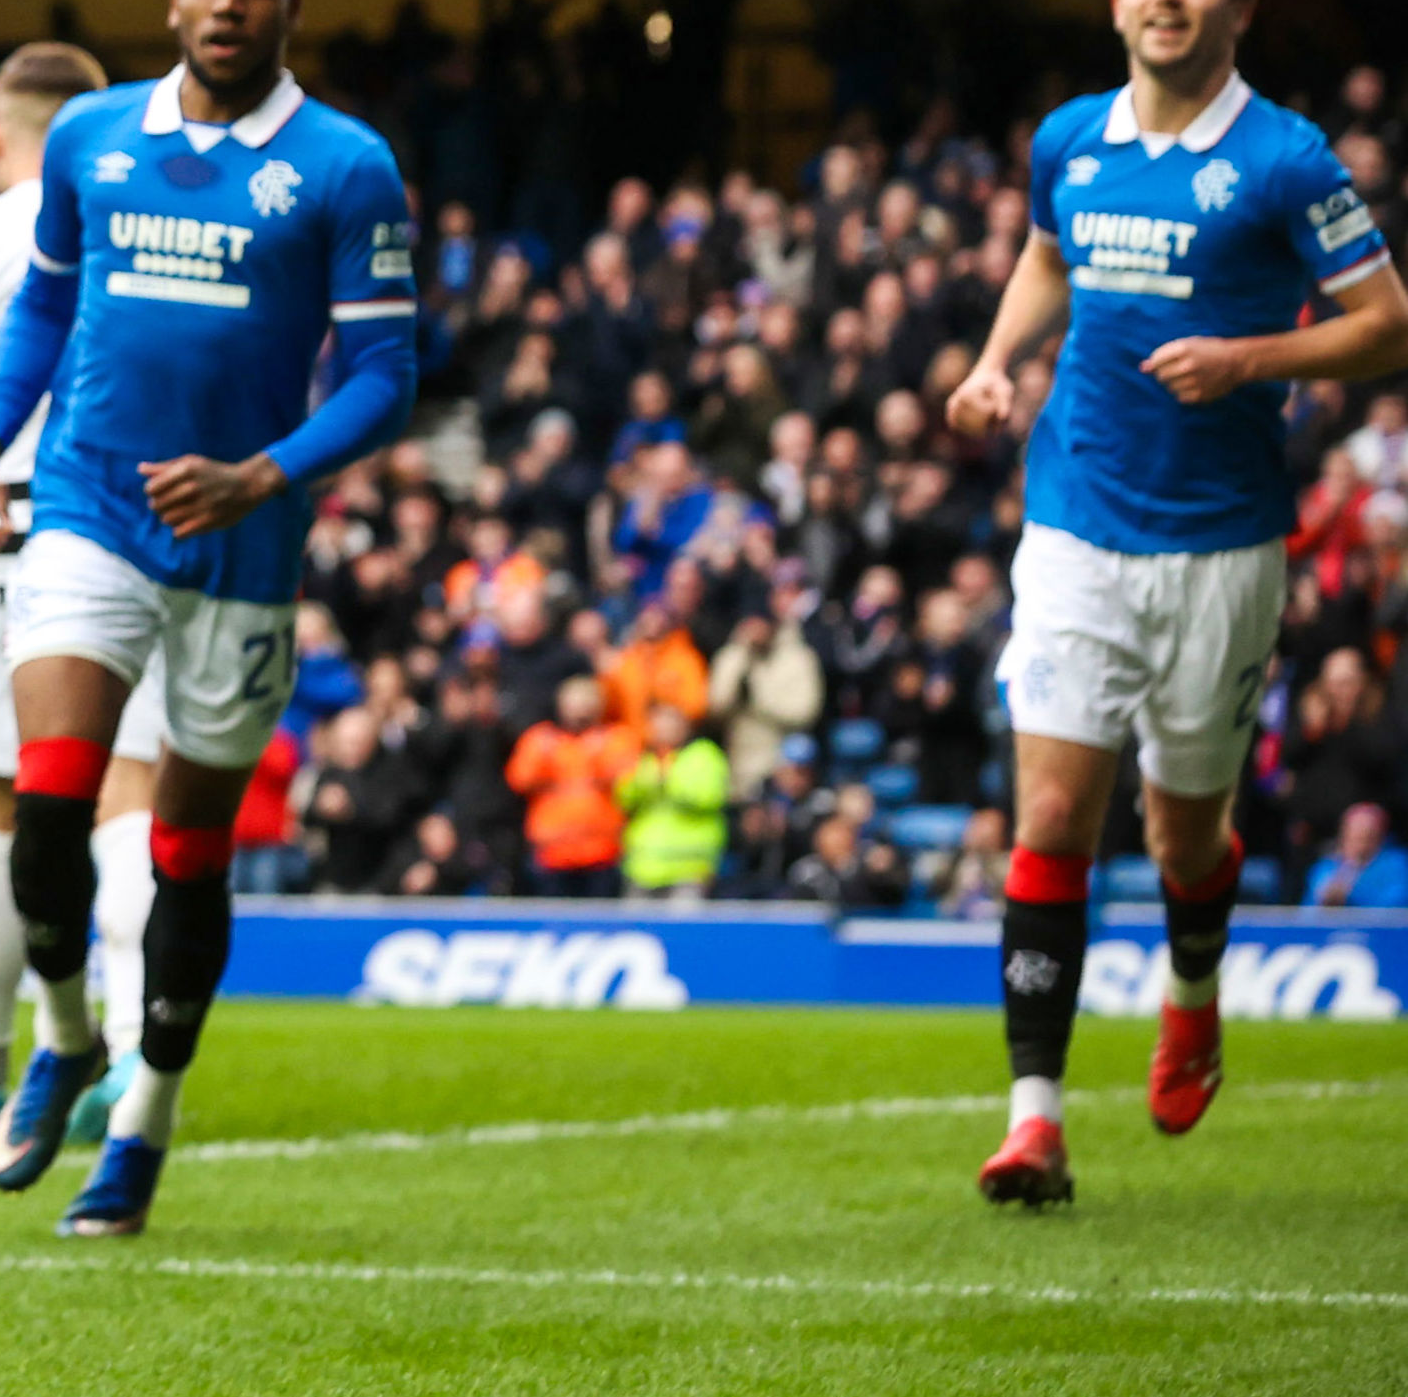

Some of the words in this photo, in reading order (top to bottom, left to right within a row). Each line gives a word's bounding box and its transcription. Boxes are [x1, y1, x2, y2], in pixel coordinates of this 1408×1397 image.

[109, 212, 254, 263] UNIBET
[1071, 212, 1197, 258] UNIBET
[359, 928, 683, 1008] SEKO
